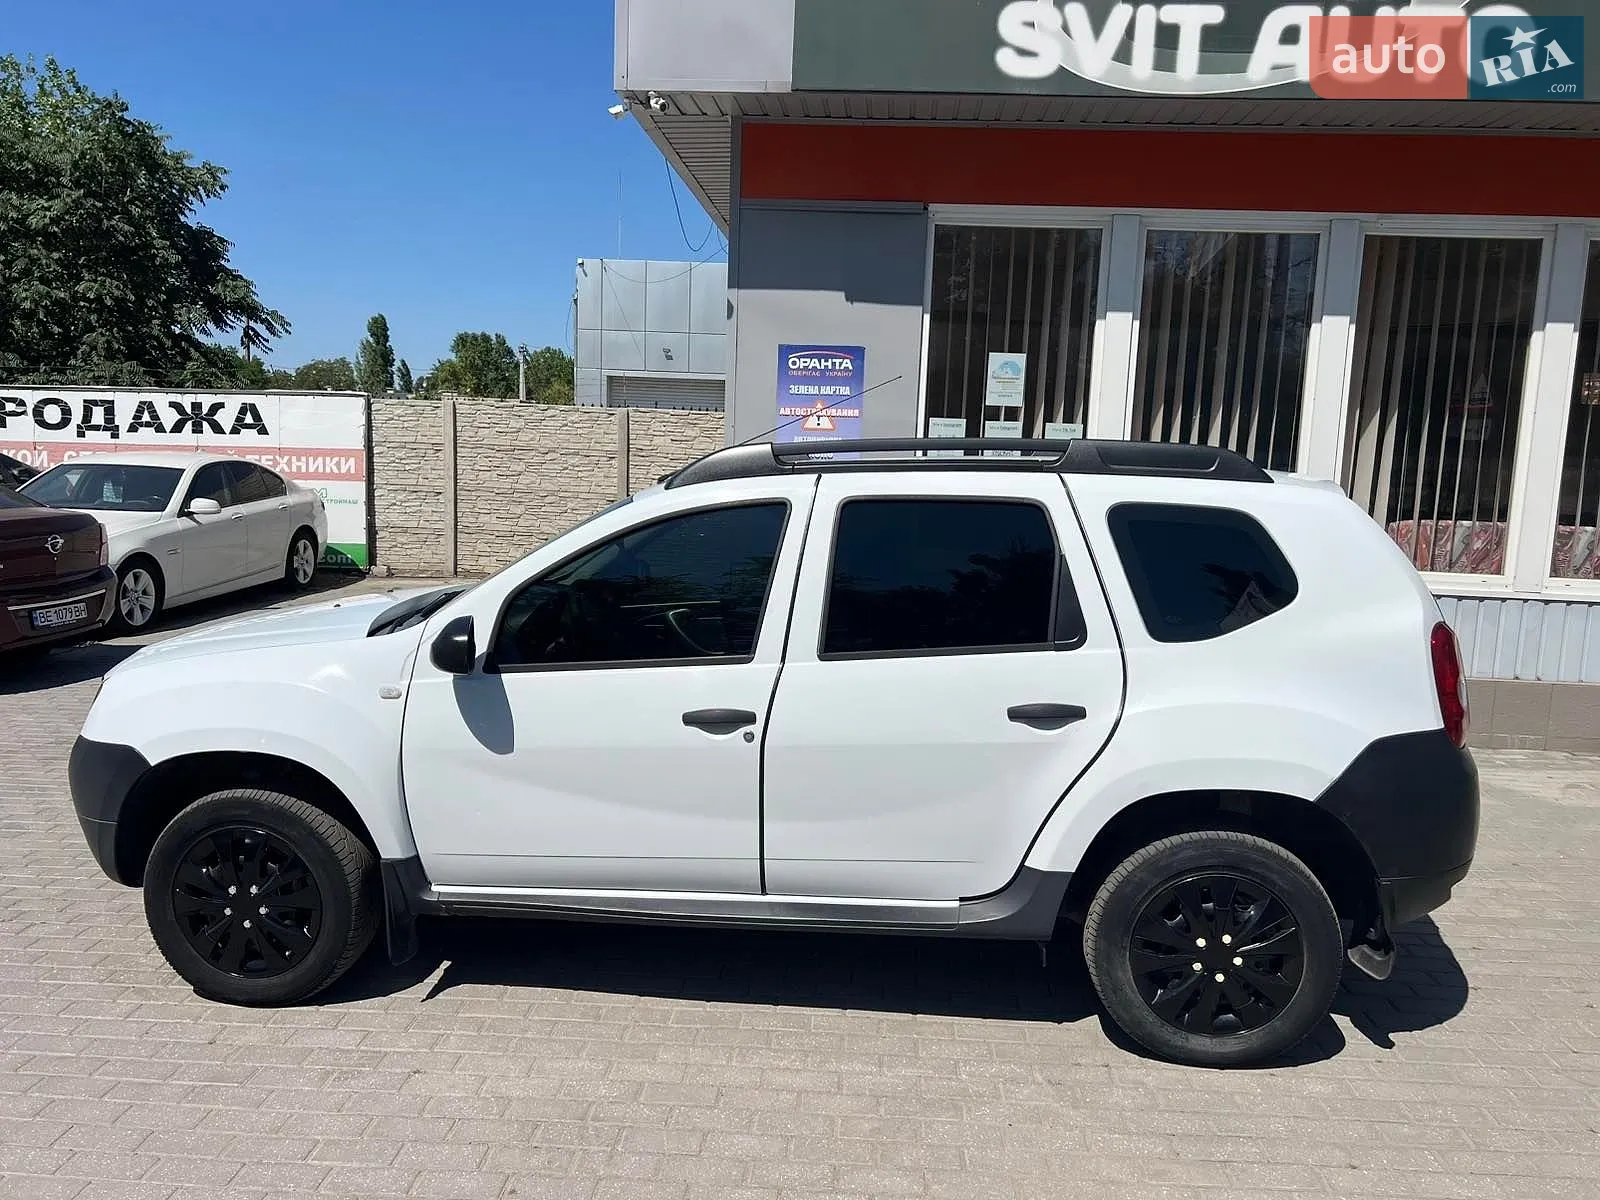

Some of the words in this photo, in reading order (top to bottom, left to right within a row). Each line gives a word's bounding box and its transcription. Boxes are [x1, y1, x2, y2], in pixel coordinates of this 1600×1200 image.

[995, 0, 1225, 79] SVIT
[1247, 4, 1538, 84] AUTO
[788, 357, 853, 370] ОРАНТА
[789, 384, 819, 395] ЗЕЛЕНА
[820, 385, 851, 396] КАРТКА
[0, 396, 270, 440] РОДАЖА
[38, 610, 52, 624] BE
[54, 607, 72, 620] 1079
